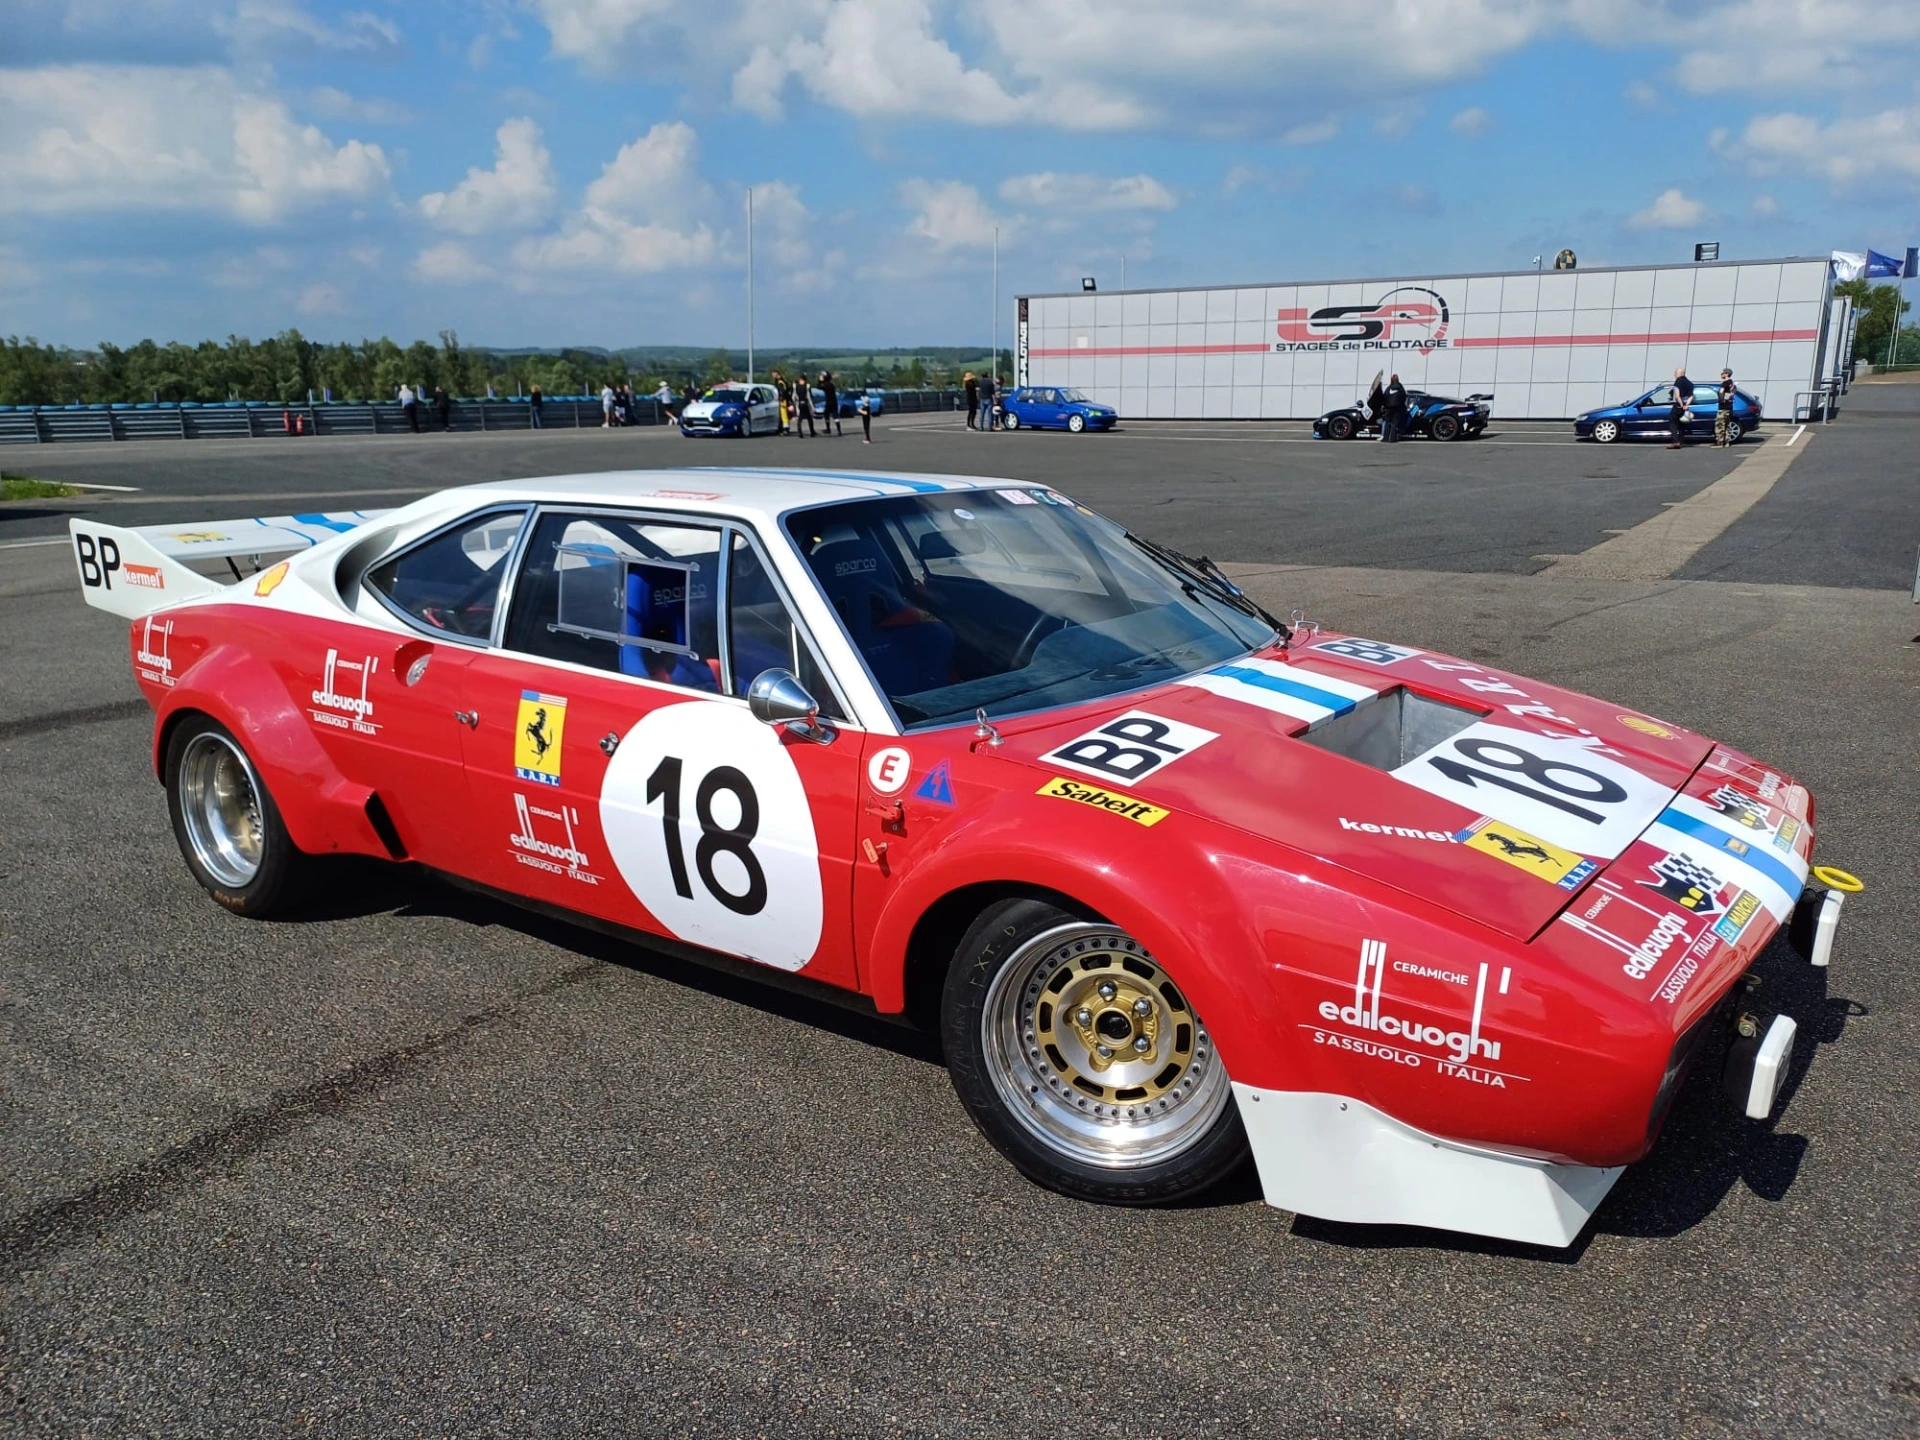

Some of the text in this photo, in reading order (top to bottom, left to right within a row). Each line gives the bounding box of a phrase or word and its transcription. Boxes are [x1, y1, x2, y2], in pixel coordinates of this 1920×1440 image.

[1276, 339, 1448, 352] STAGES de PILOTAGE
[76, 533, 121, 590] BP
[835, 558, 877, 576] sparco
[124, 567, 162, 588] kermel
[1317, 639, 1410, 663] BP
[1052, 717, 1185, 780] BP
[516, 768, 559, 787] N.A.R.T.
[879, 755, 900, 783] E
[1428, 738, 1628, 825] 18
[1051, 781, 1153, 820] Sabelt
[646, 756, 768, 916] 18
[1338, 817, 1458, 844] kermel
[516, 854, 598, 885] SASSUOLO ITALIA
[1558, 859, 1597, 890] N.A.R.T.
[1393, 961, 1469, 985] CERAMICHE
[1661, 930, 1719, 1003] SASSUOLO ITALIA
[1313, 1031, 1506, 1089] SASSUOLO ITALIA
